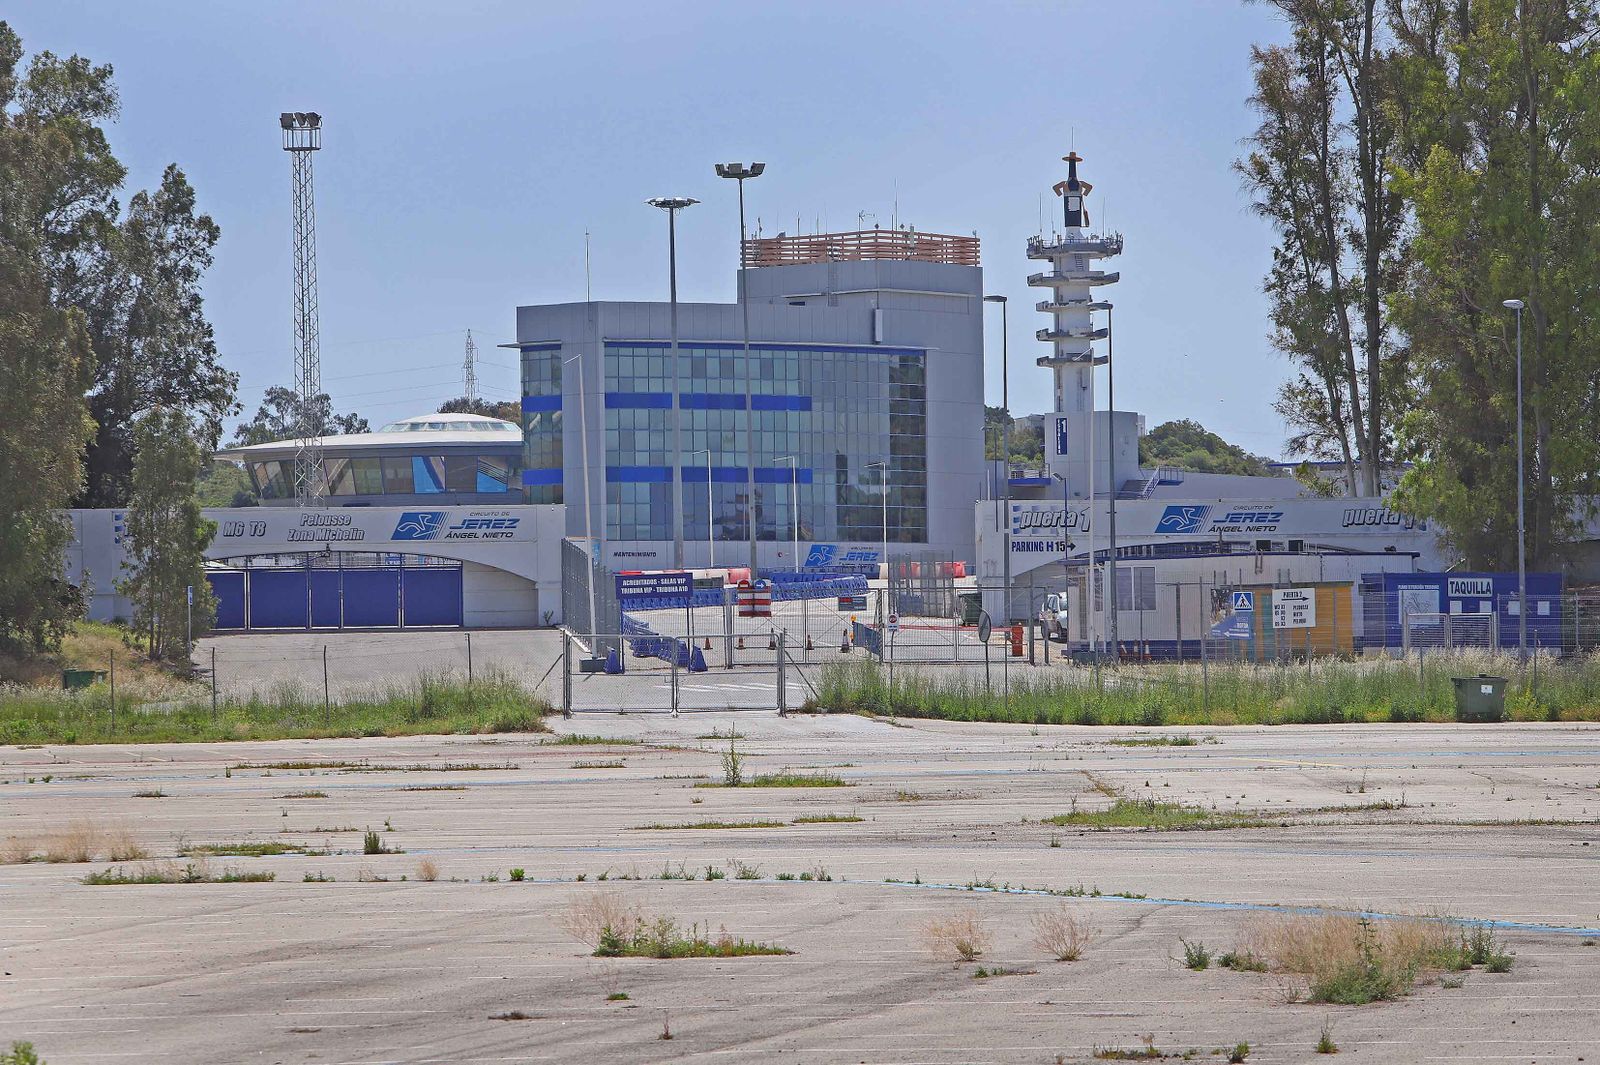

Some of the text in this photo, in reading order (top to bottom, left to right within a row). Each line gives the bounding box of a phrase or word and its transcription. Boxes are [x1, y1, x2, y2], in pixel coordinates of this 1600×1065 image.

[300, 513, 351, 526] Pelousse
[1020, 507, 1091, 532] puerta 1
[1213, 512, 1284, 523] JEREZ
[1343, 507, 1400, 527] puerta
[223, 521, 266, 537] M6 T8
[449, 519, 520, 529] JEREZ
[287, 527, 365, 541] Zona Michelin
[1012, 541, 1043, 552] PARKING
[1055, 541, 1066, 552] 15
[839, 552, 879, 560] JEREZ
[1450, 581, 1491, 594] TAQUILLA
